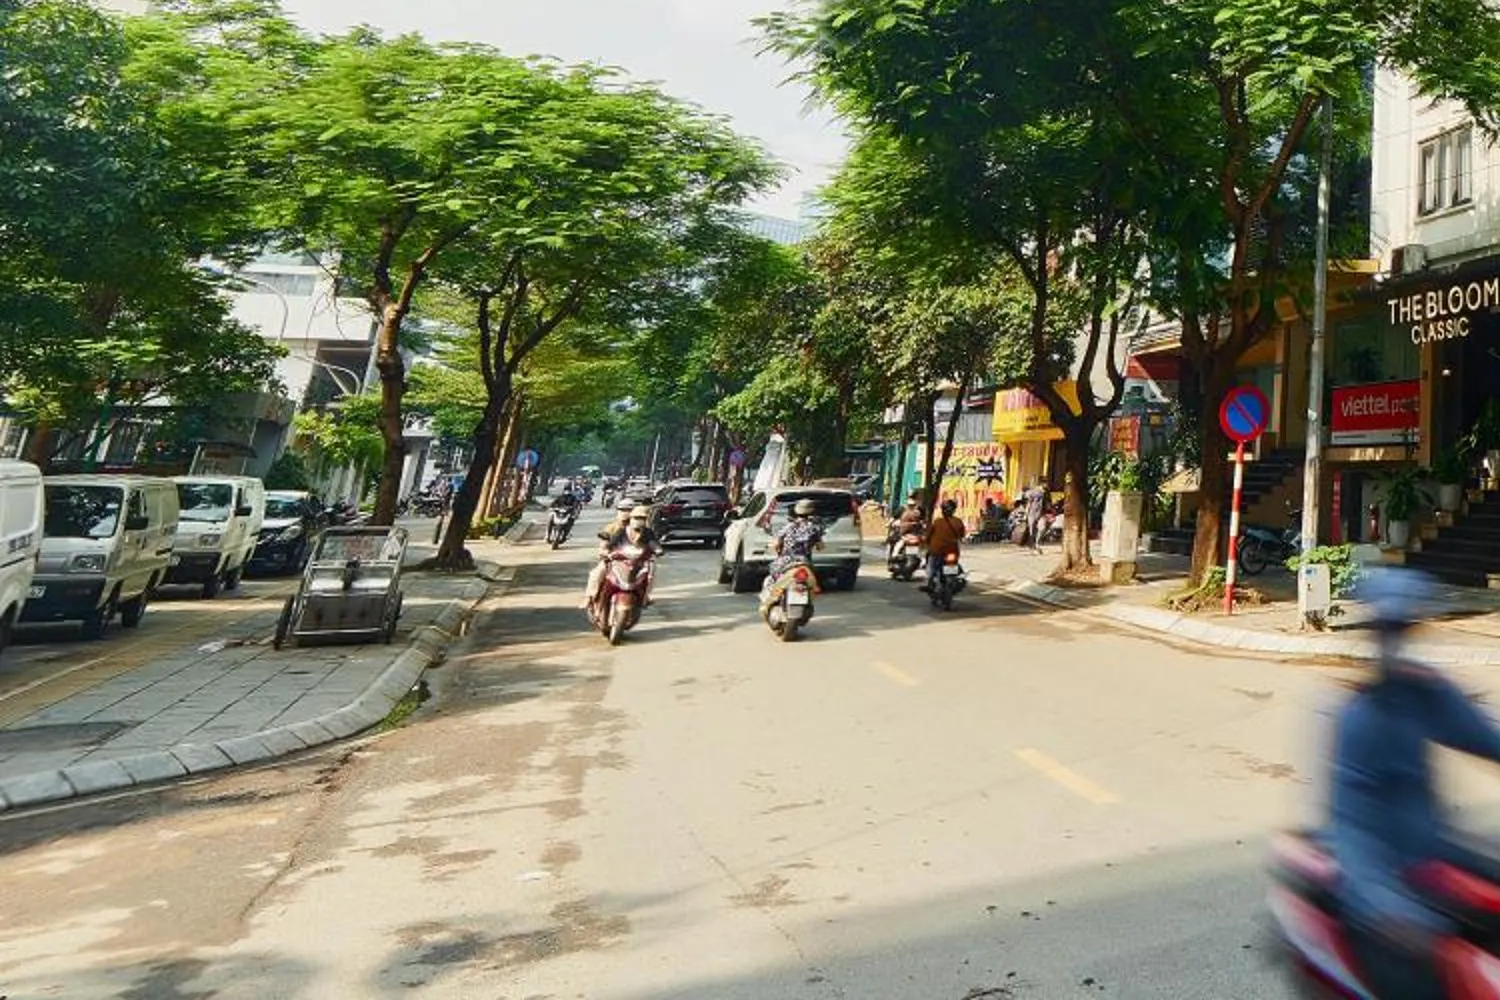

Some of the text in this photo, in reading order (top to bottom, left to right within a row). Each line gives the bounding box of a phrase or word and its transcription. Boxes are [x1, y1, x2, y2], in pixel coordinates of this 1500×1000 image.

[1387, 277, 1500, 325] THE BLOOM
[1411, 316, 1469, 345] CLASSIC
[1340, 393, 1390, 417] viettel
